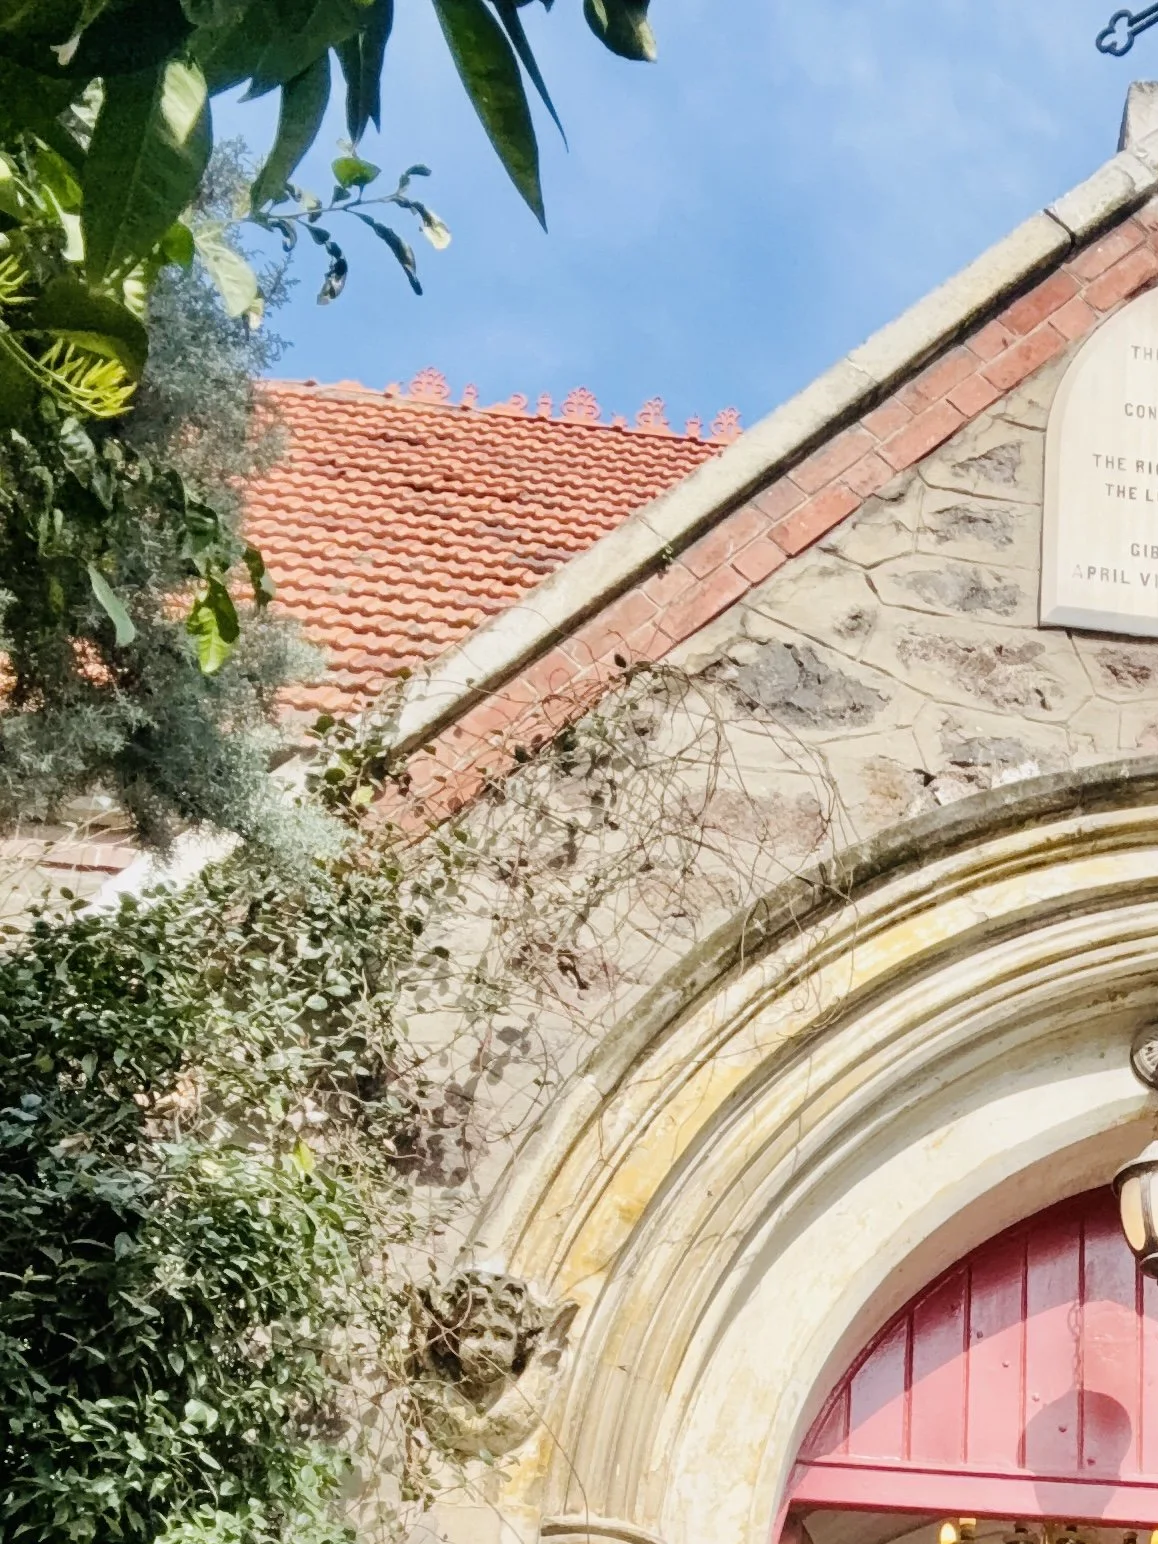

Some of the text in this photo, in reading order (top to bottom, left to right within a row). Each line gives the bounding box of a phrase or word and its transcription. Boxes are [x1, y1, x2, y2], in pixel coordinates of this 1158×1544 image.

[1092, 454, 1127, 471] THE
[1105, 483, 1137, 500] THE
[1072, 564, 1131, 585] APRIL
